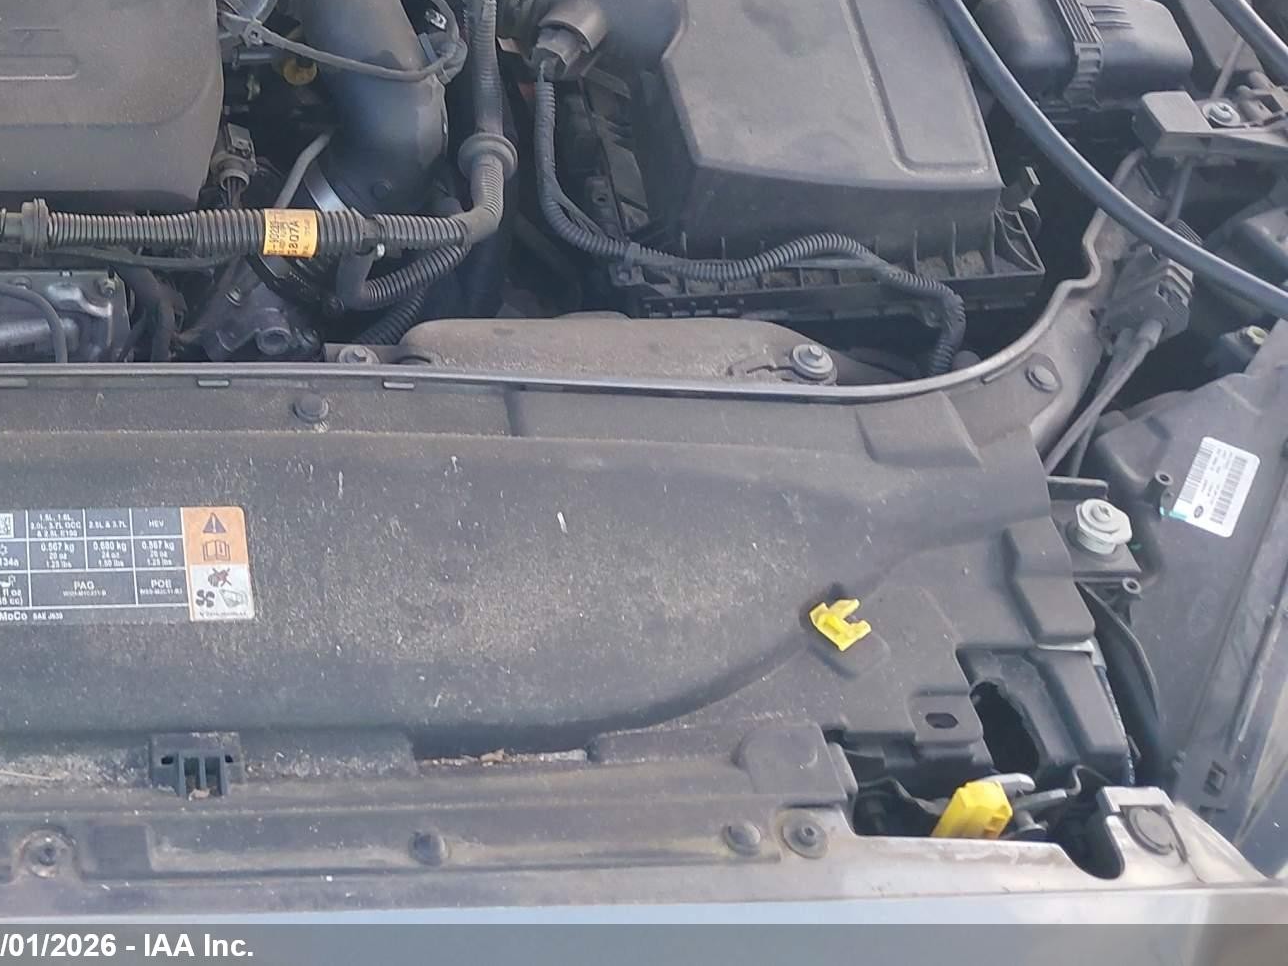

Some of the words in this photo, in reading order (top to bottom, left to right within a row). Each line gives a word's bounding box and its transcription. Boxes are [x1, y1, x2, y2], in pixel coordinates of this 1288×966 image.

[149, 519, 165, 528] HEV
[64, 542, 75, 553] kg
[116, 541, 127, 552] kg
[164, 540, 175, 552] kg
[73, 580, 95, 590] PAG
[2, 588, 10, 597] fl
[11, 589, 22, 597] oz
